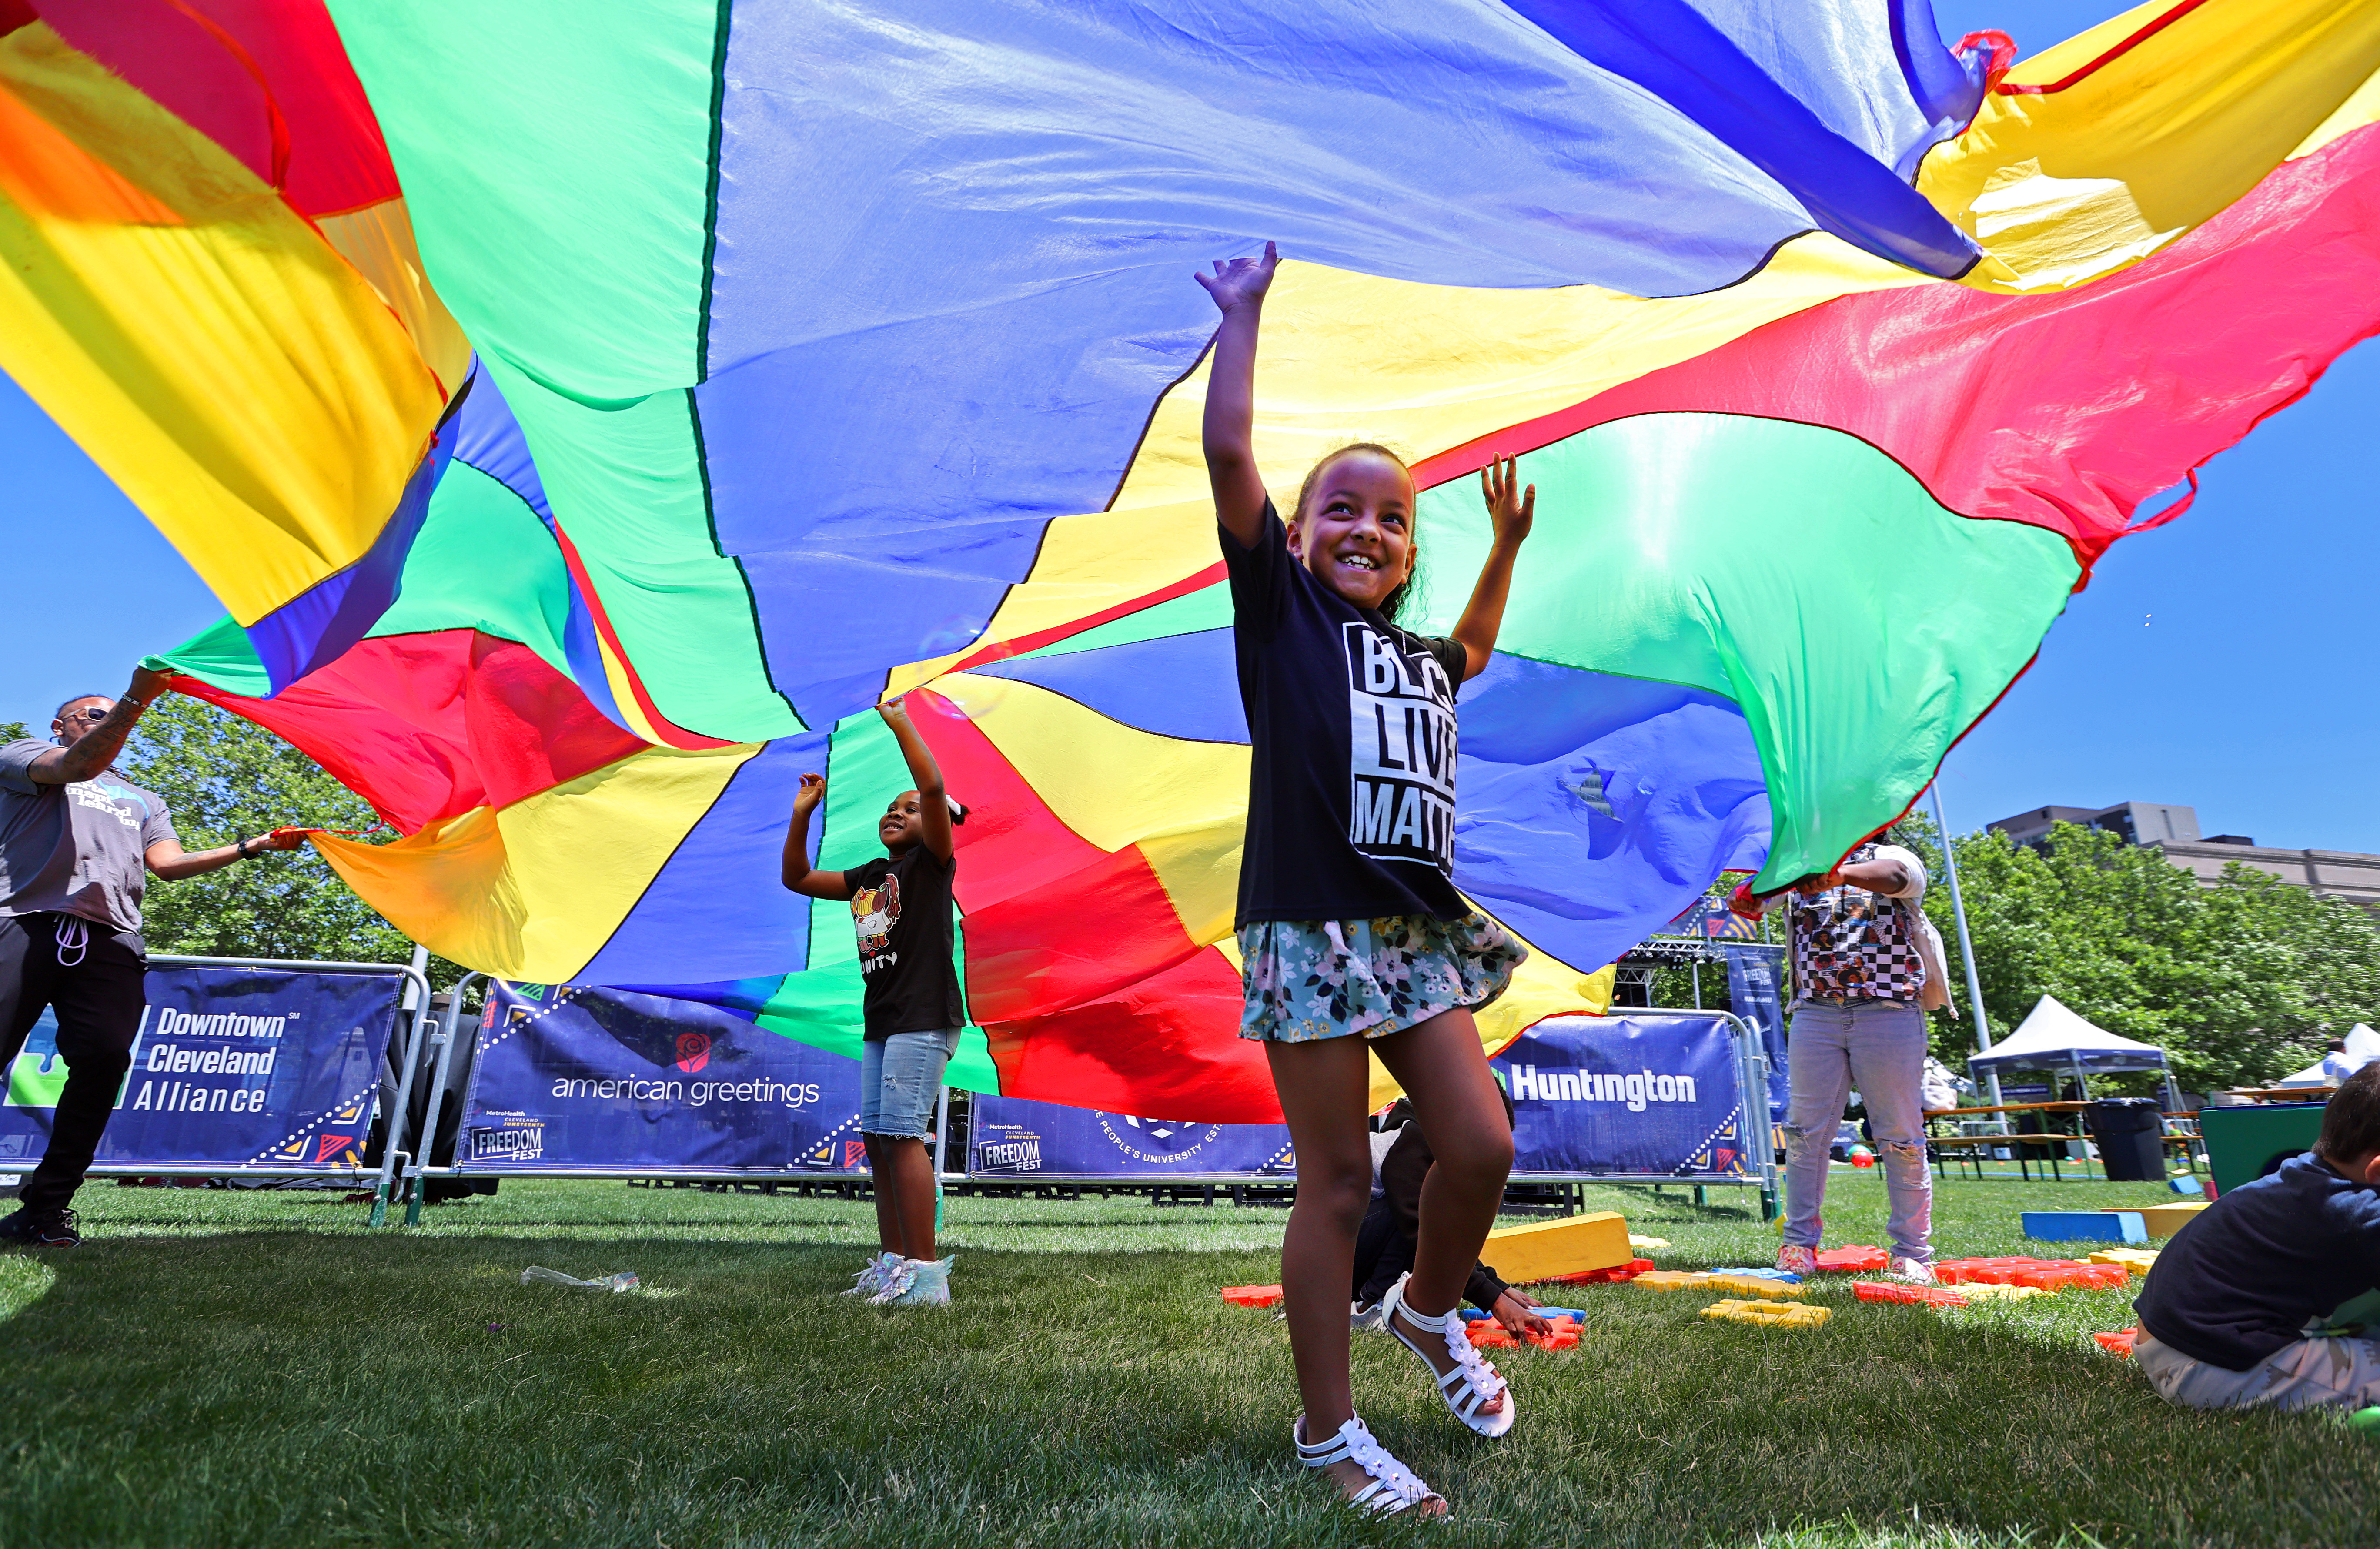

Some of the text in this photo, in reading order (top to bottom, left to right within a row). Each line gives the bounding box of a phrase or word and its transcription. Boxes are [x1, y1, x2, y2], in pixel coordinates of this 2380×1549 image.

[1375, 703, 1457, 786] LIVE
[861, 952, 897, 974] UNITY
[157, 1008, 285, 1037] Downtown
[147, 1044, 277, 1074] Cleveland
[133, 1081, 265, 1112] Alliance
[552, 1074, 819, 1108] american greetings
[1511, 1064, 1696, 1112] Huntington
[478, 1128, 541, 1154] FREEDOM
[512, 1148, 543, 1161] FEST
[986, 1140, 1040, 1165] FREEDOM
[1100, 1120, 1140, 1158] PEOPLE'S
[1143, 1143, 1202, 1164] UNIVERSITY
[1016, 1159, 1042, 1171] FEST
